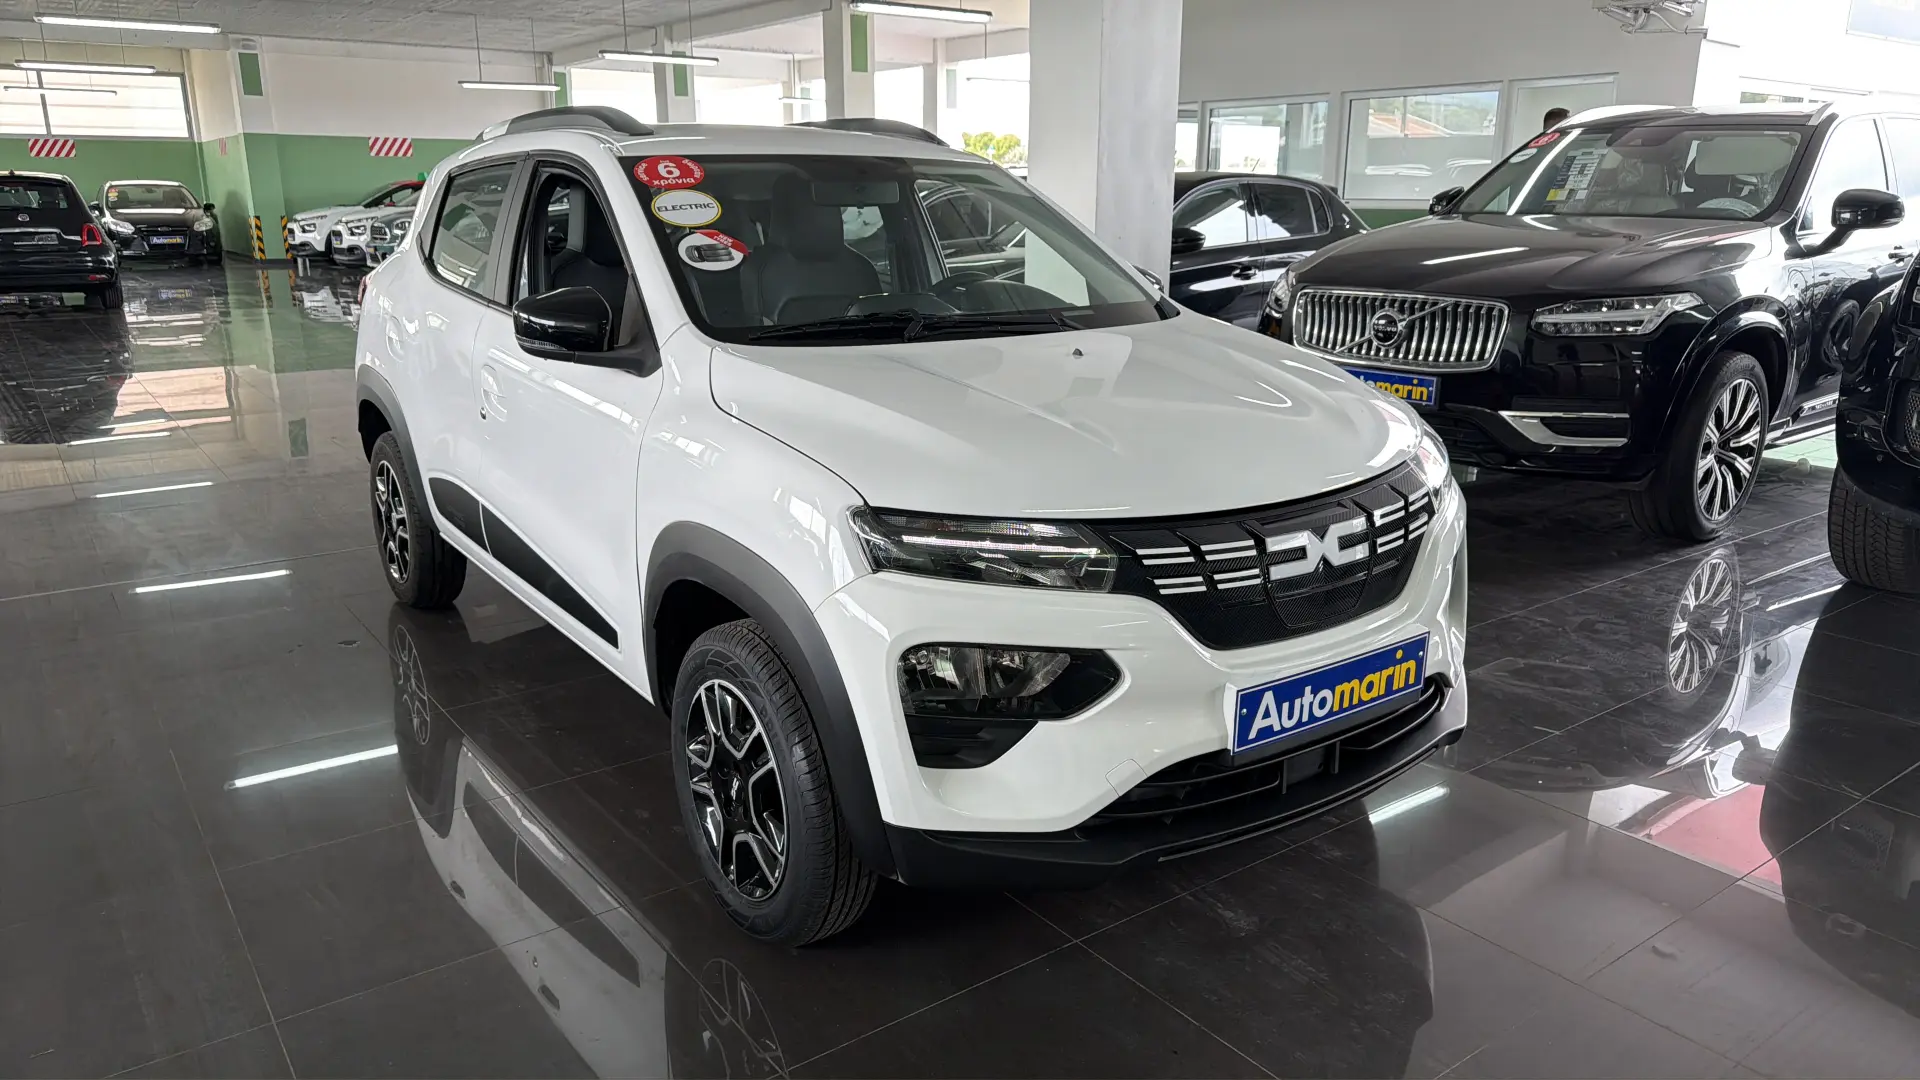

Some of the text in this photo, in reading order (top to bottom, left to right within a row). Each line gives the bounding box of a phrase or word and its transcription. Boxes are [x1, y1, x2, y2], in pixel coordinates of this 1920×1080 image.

[658, 162, 681, 178] 6
[657, 203, 716, 212] ELECTRIC
[1359, 375, 1429, 401] omarin
[1247, 649, 1417, 740] Automarin
